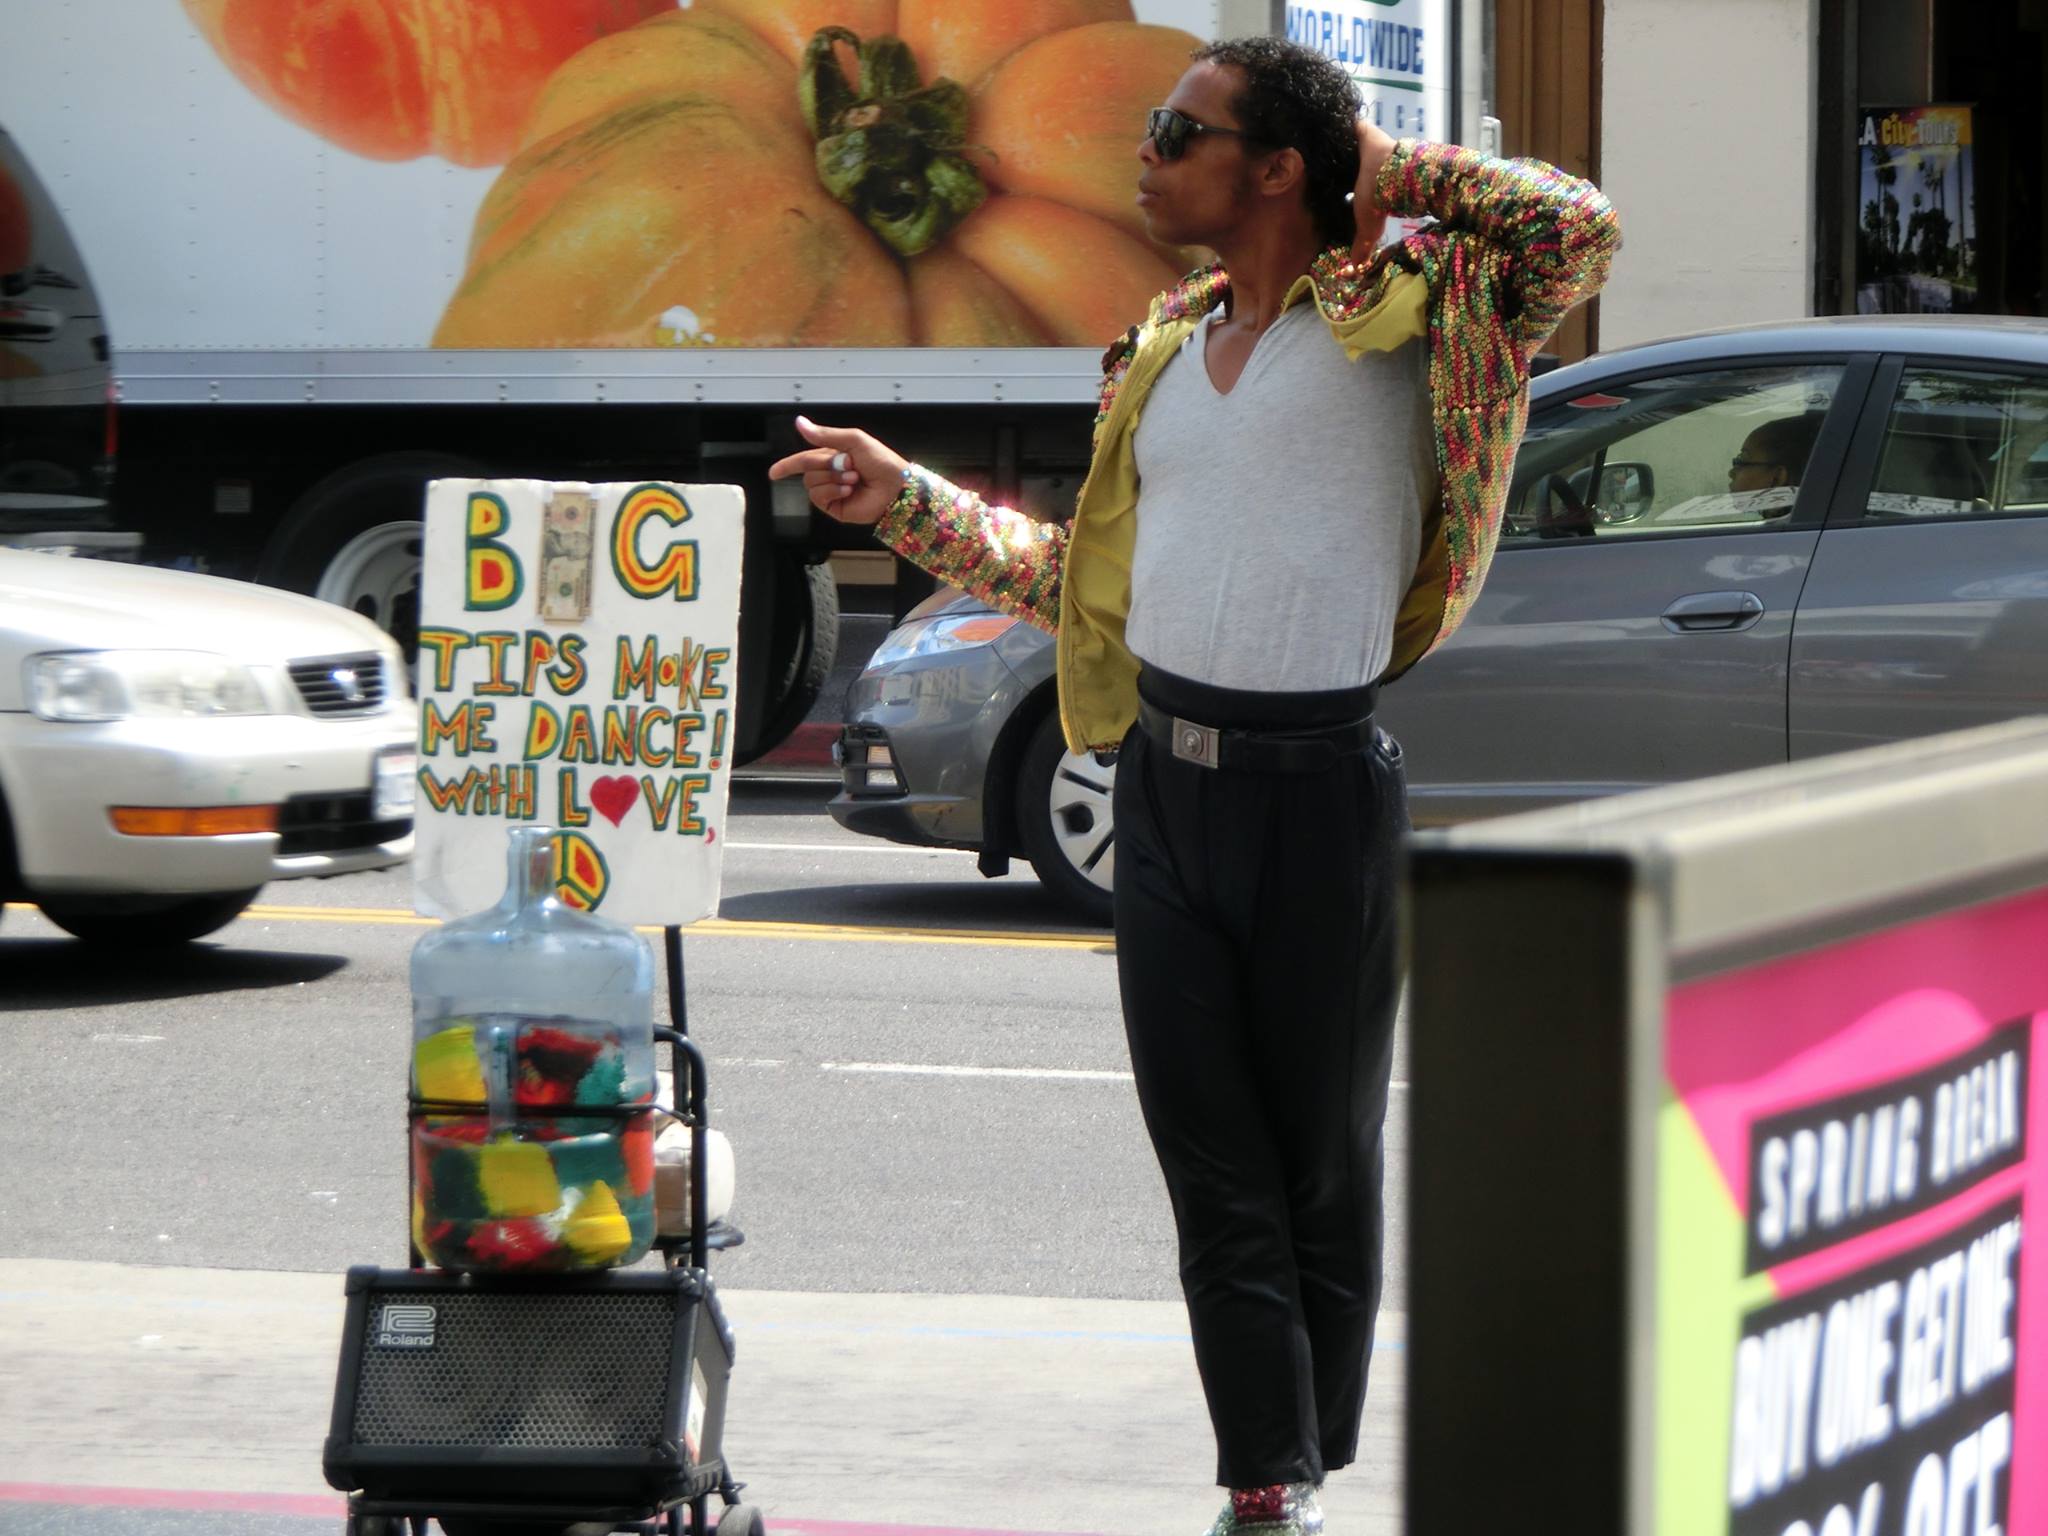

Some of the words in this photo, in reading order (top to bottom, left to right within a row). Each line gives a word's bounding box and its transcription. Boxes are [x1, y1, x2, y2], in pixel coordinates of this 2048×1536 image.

[1286, 6, 1424, 74] WORLDWIDE
[1881, 112, 1915, 147] City
[419, 625, 588, 697] TIPS
[422, 698, 497, 757] ME
[523, 700, 729, 770] DANCE!
[1758, 1095, 1922, 1250] SPRING
[380, 1333, 434, 1346] Roland
[1730, 1311, 1823, 1509] BUY
[1816, 1279, 1902, 1467] ONE
[1898, 1250, 1966, 1430] GET
[1962, 1214, 2022, 1396] ONE
